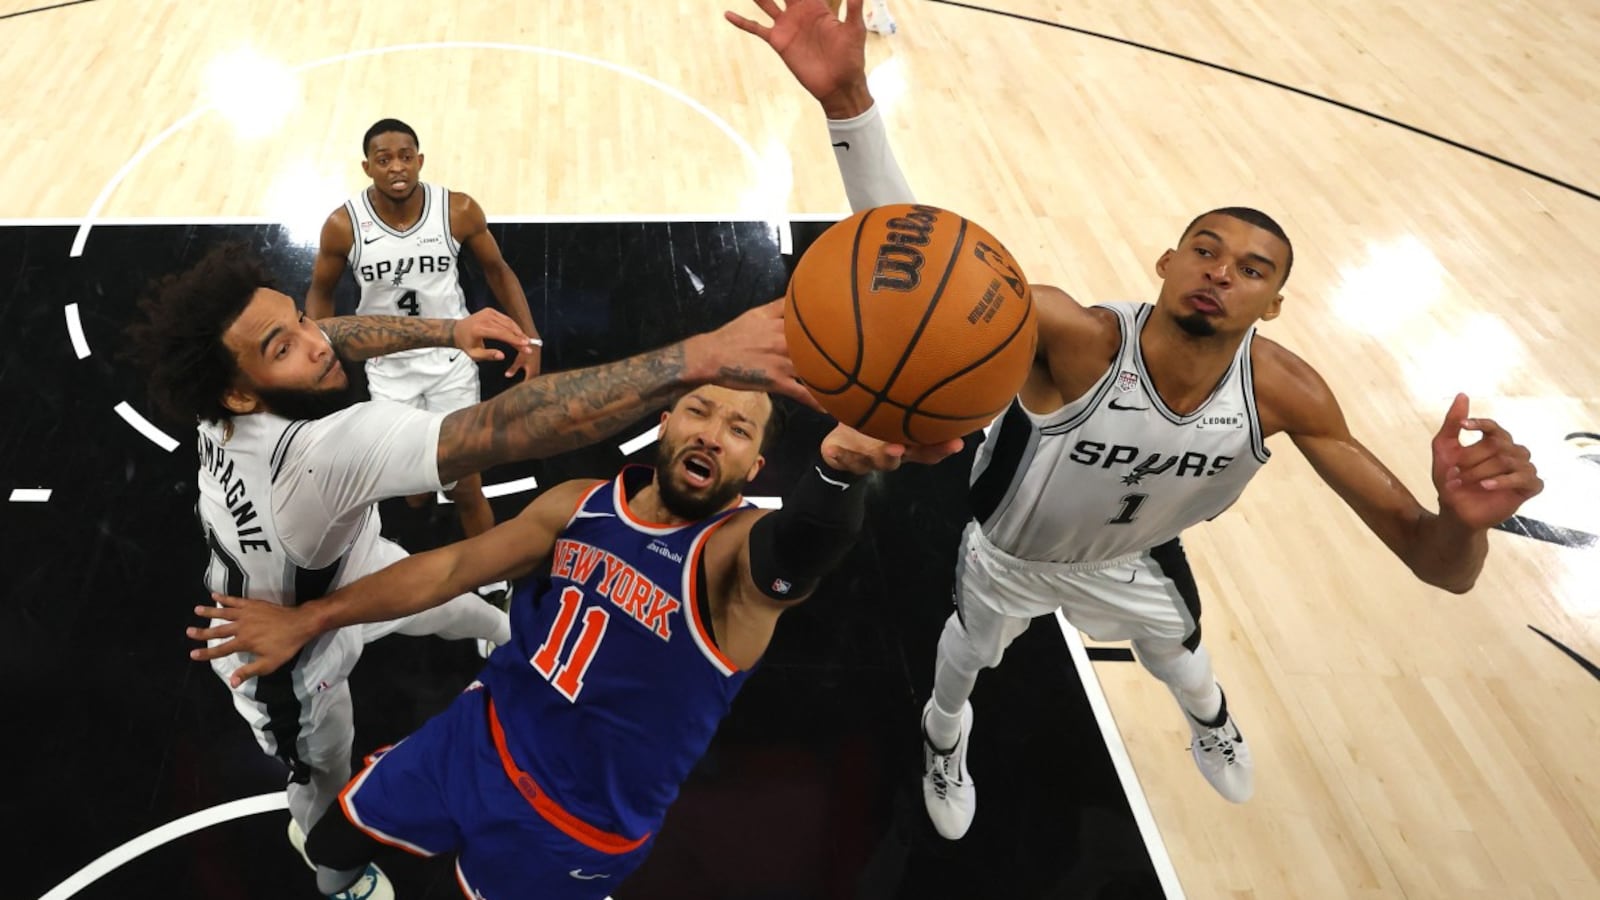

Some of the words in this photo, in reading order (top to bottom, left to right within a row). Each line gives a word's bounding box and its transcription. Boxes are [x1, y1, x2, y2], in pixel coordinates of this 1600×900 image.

[361, 256, 450, 286] SPURS
[397, 290, 419, 316] 4
[1203, 417, 1239, 425] LEDGER
[1069, 440, 1234, 487] SPURS
[1106, 494, 1149, 525] 1
[551, 539, 602, 585] NEW
[596, 552, 681, 642] YORK
[530, 586, 610, 703] 11
